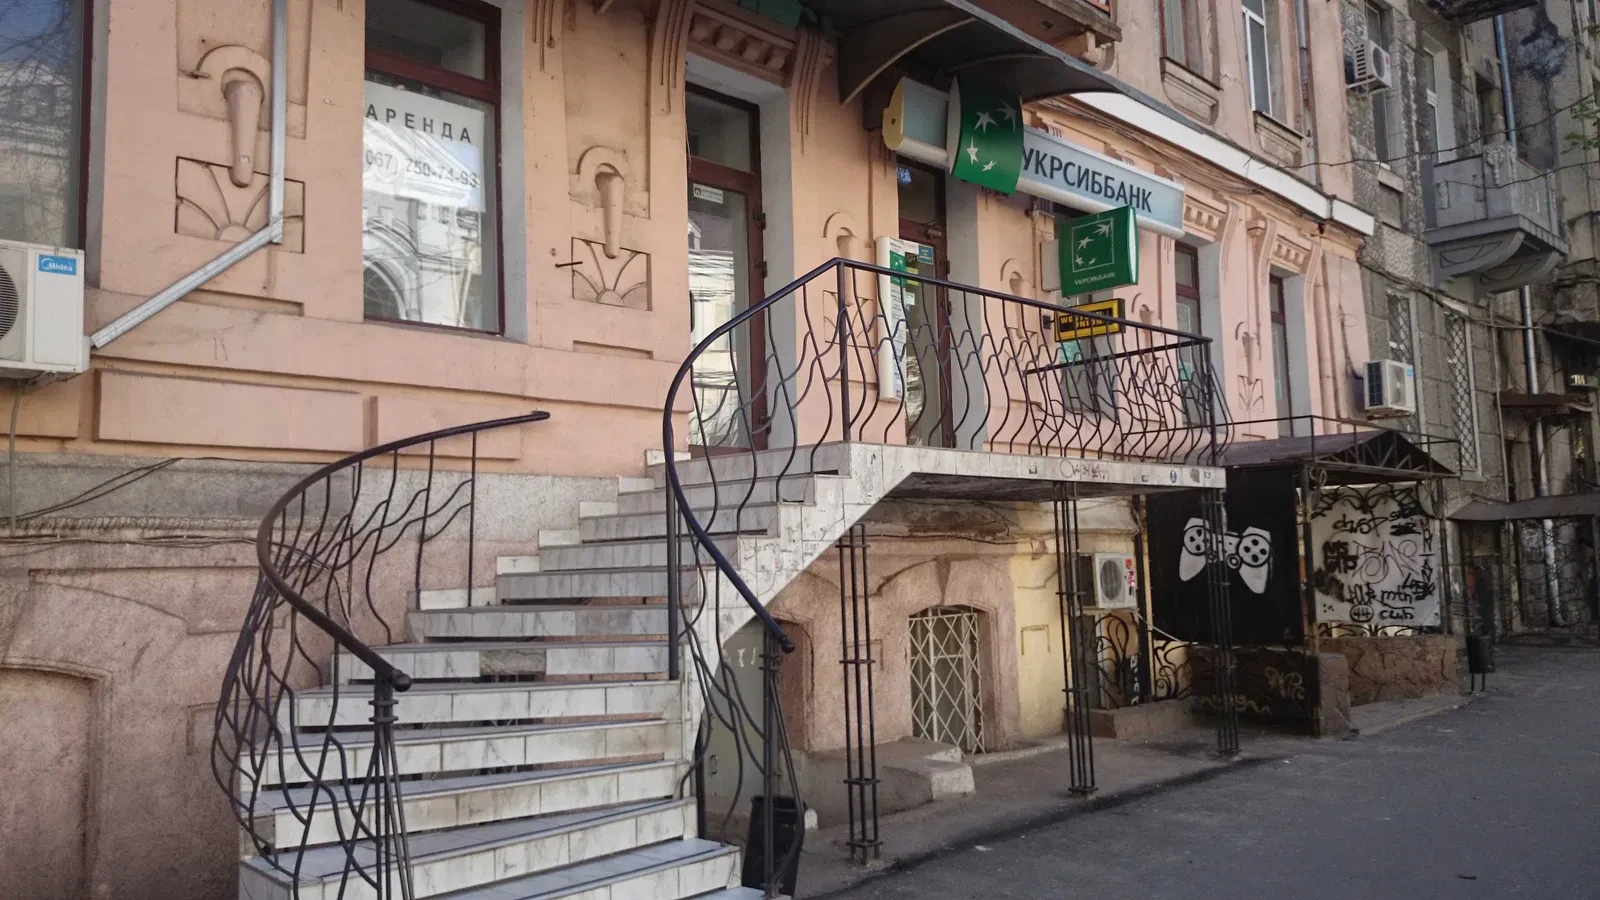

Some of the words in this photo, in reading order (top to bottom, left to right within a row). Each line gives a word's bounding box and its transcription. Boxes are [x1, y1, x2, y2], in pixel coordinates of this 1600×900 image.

[365, 103, 472, 143] АРЕНДА
[1022, 145, 1152, 213] УКРСИББАНК
[41, 257, 73, 272] Midea
[1074, 272, 1116, 285] УКРСИББАНК
